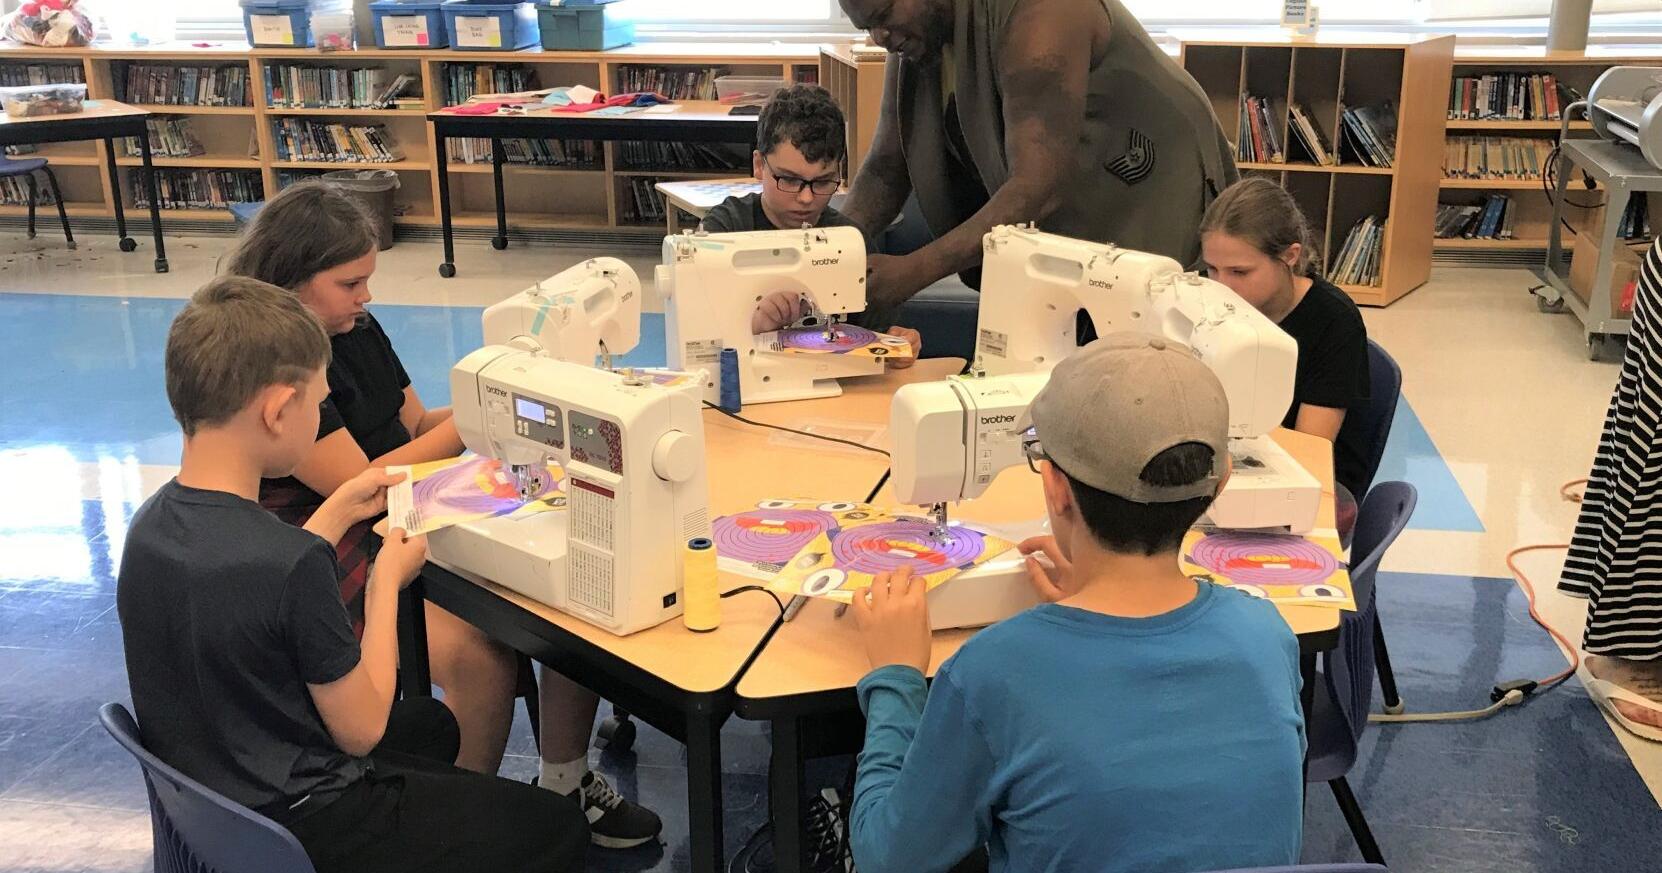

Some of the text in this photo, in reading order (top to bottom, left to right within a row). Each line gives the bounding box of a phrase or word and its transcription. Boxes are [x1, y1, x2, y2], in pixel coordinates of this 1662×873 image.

[811, 258, 839, 266] brother
[1089, 278, 1113, 290] brother
[485, 384, 508, 397] brother
[981, 414, 1016, 424] brother
